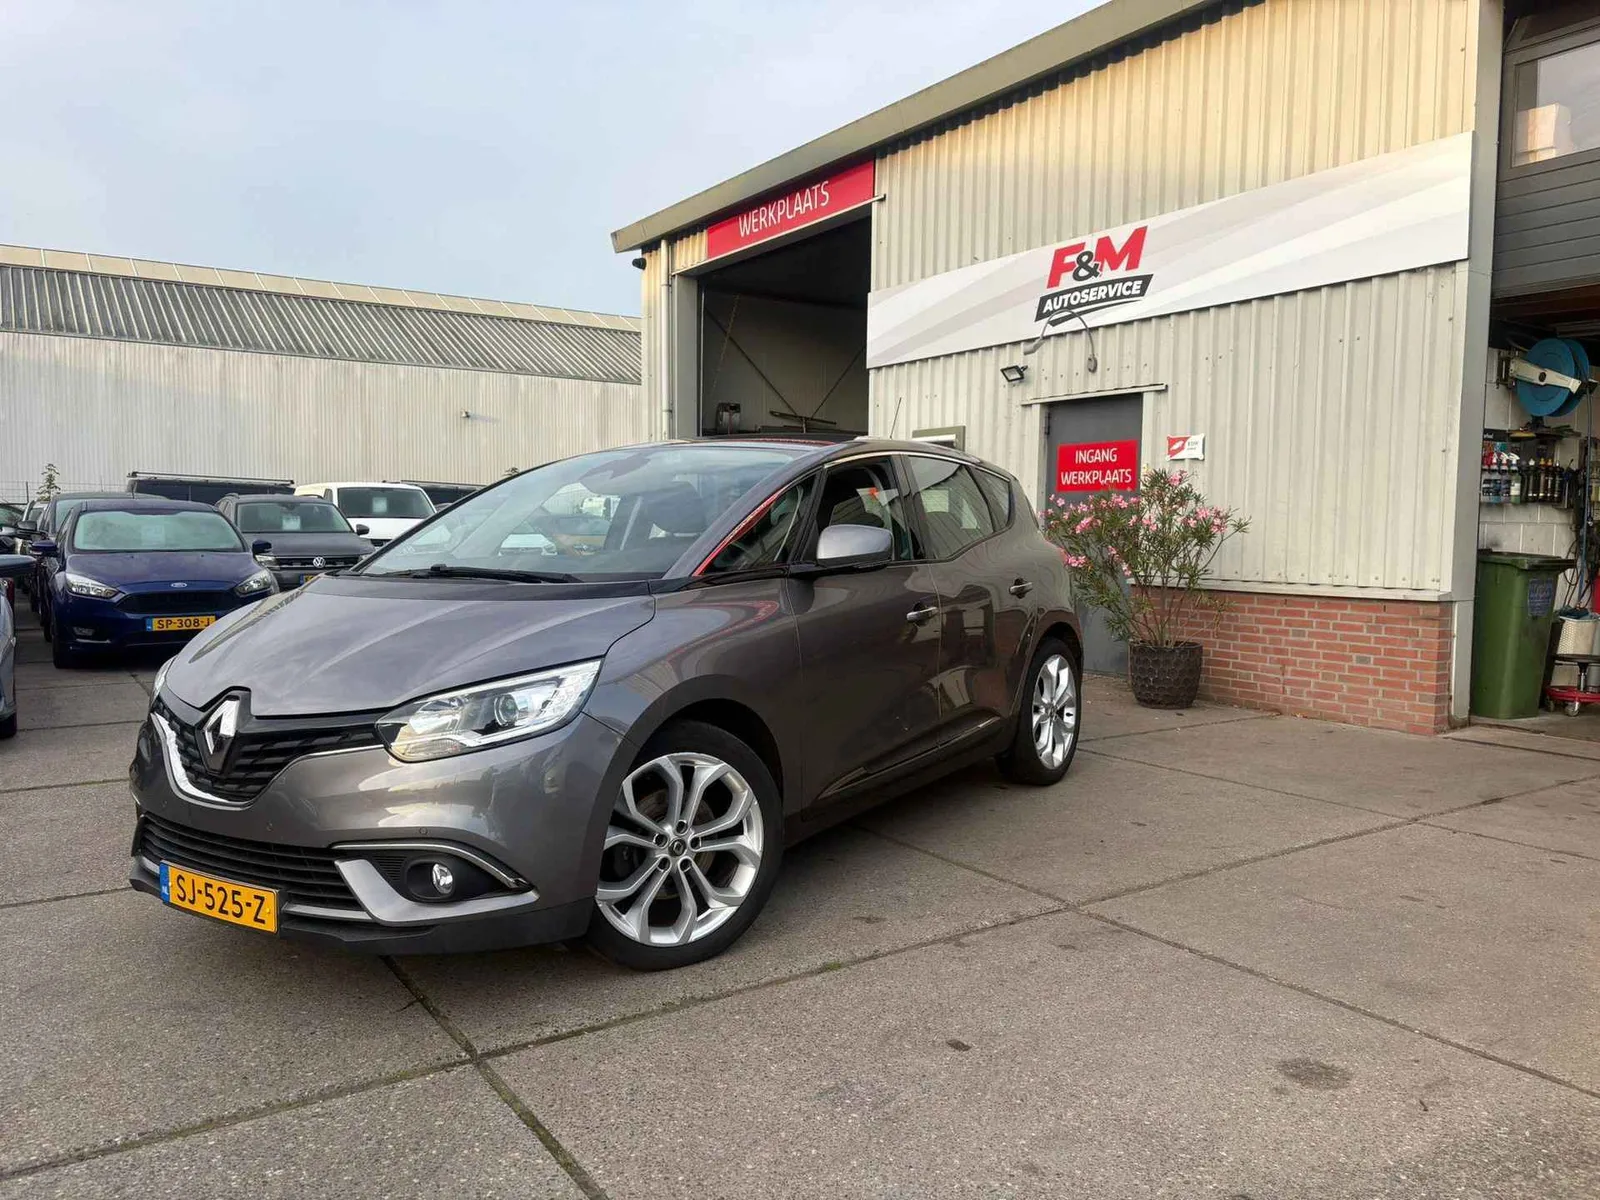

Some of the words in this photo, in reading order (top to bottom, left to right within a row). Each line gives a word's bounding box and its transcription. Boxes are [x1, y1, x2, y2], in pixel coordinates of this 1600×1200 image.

[738, 180, 830, 238] WERKPLAATS
[1046, 225, 1148, 289] F&M
[1042, 280, 1143, 314] AUTOSERVICE
[1075, 447, 1118, 464] INGANG
[1060, 468, 1133, 486] WERKPLAATS
[156, 617, 210, 630] SP-308-J
[176, 873, 266, 925] SJ-525-Z
